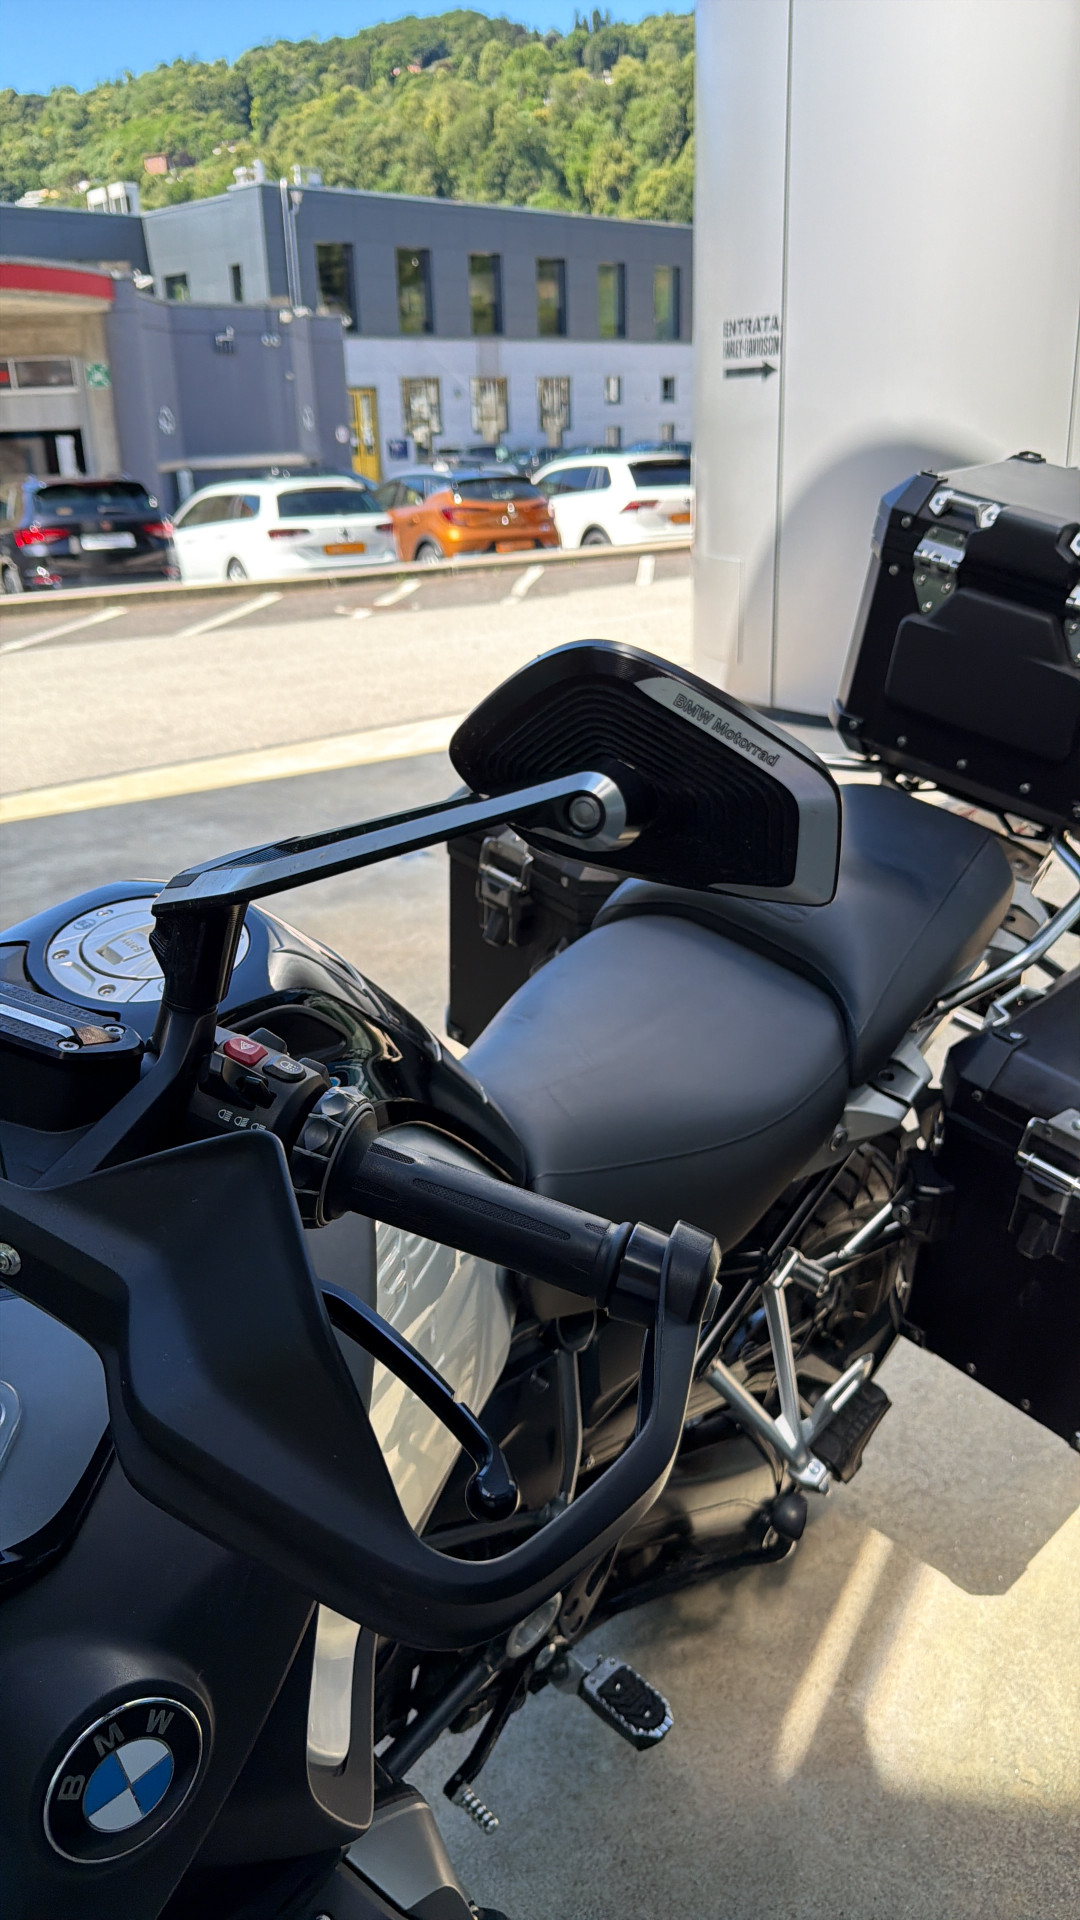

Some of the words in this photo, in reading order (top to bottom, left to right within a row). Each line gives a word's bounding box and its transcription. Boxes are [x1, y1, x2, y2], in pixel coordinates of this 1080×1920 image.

[723, 315, 779, 338] ENTRATA
[723, 335, 780, 359] HARLEY-DAVIDSON
[672, 693, 715, 725] BMW
[711, 718, 780, 767] Motorrad
[57, 1709, 175, 1801] BMW
